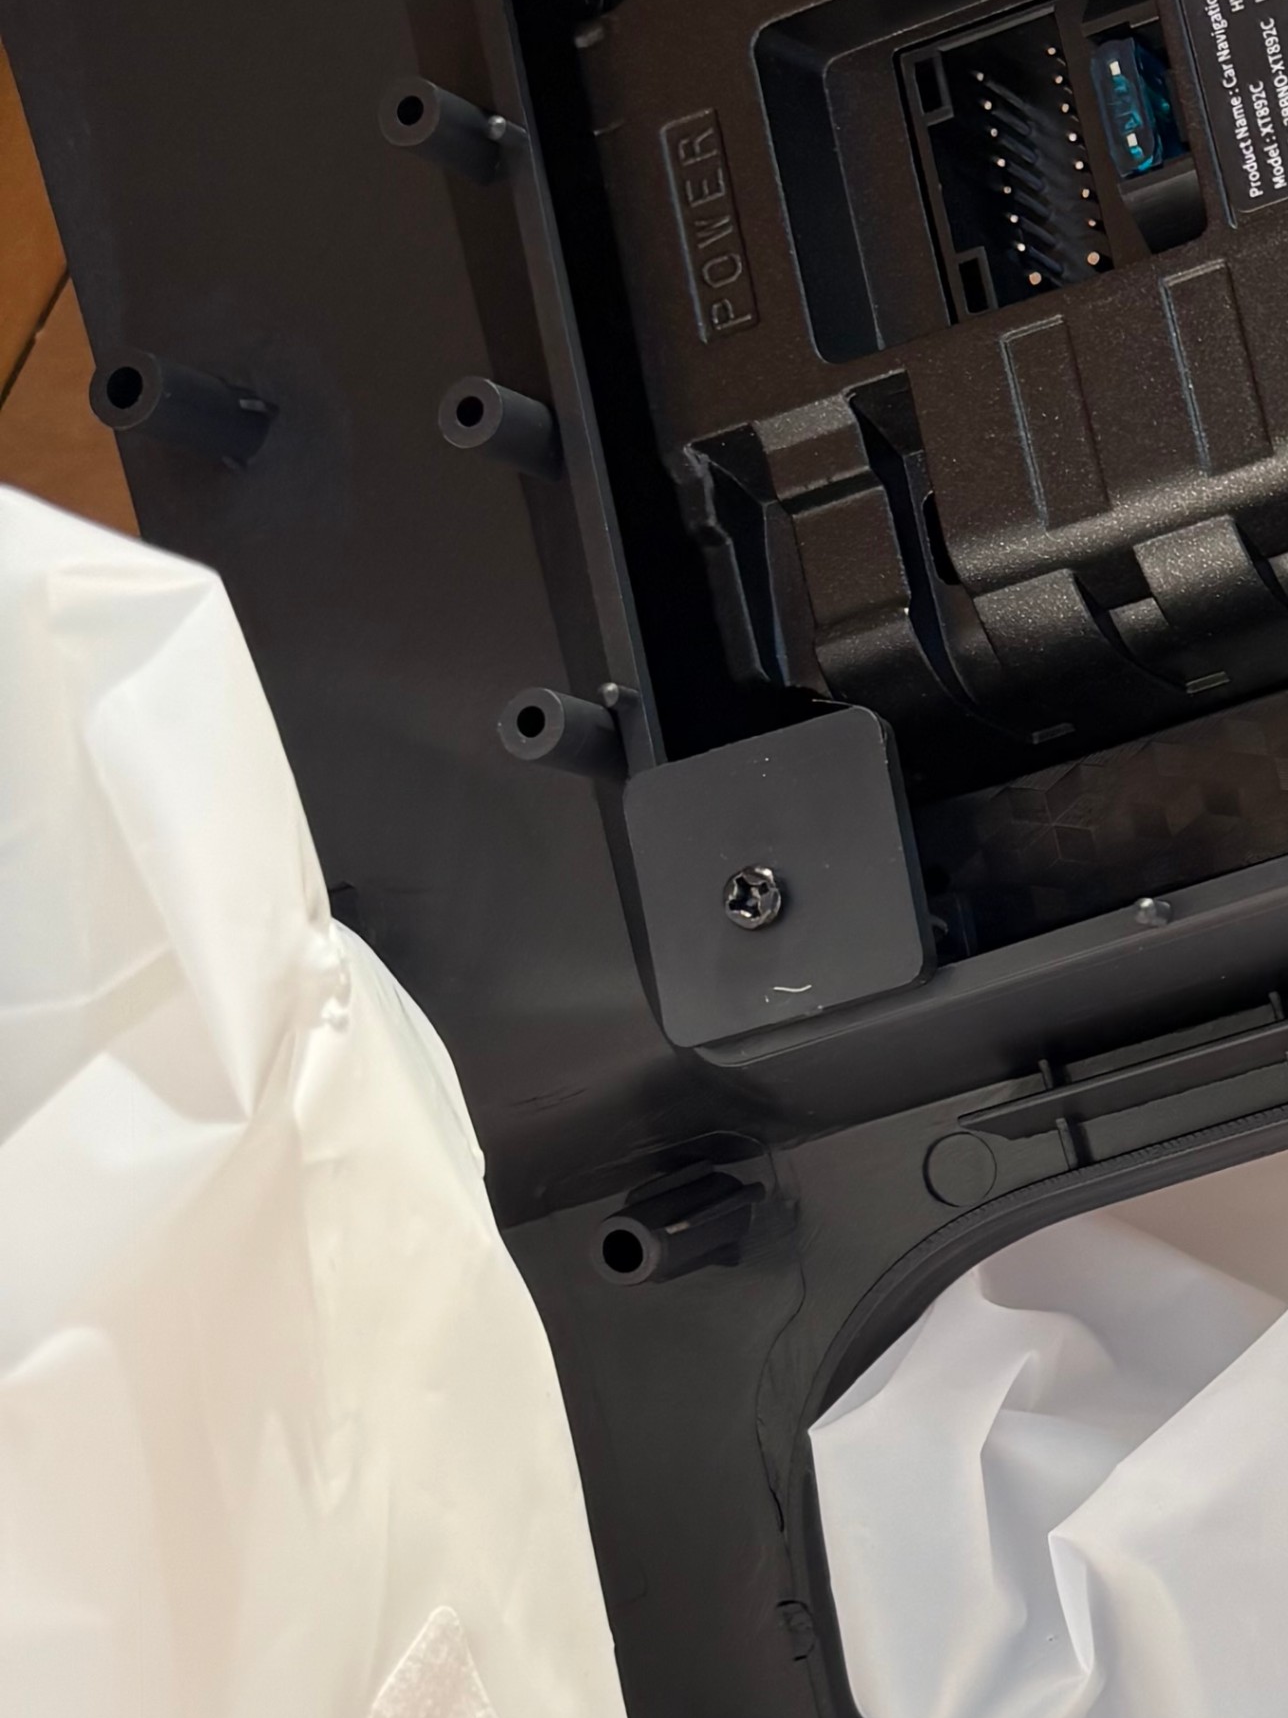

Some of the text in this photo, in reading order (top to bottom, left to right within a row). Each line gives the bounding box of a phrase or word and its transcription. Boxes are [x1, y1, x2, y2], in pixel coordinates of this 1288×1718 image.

[1221, 63, 1238, 89] Car
[1248, 80, 1275, 137] XT892C
[1238, 138, 1264, 198] Product
[678, 127, 752, 331] POWER
